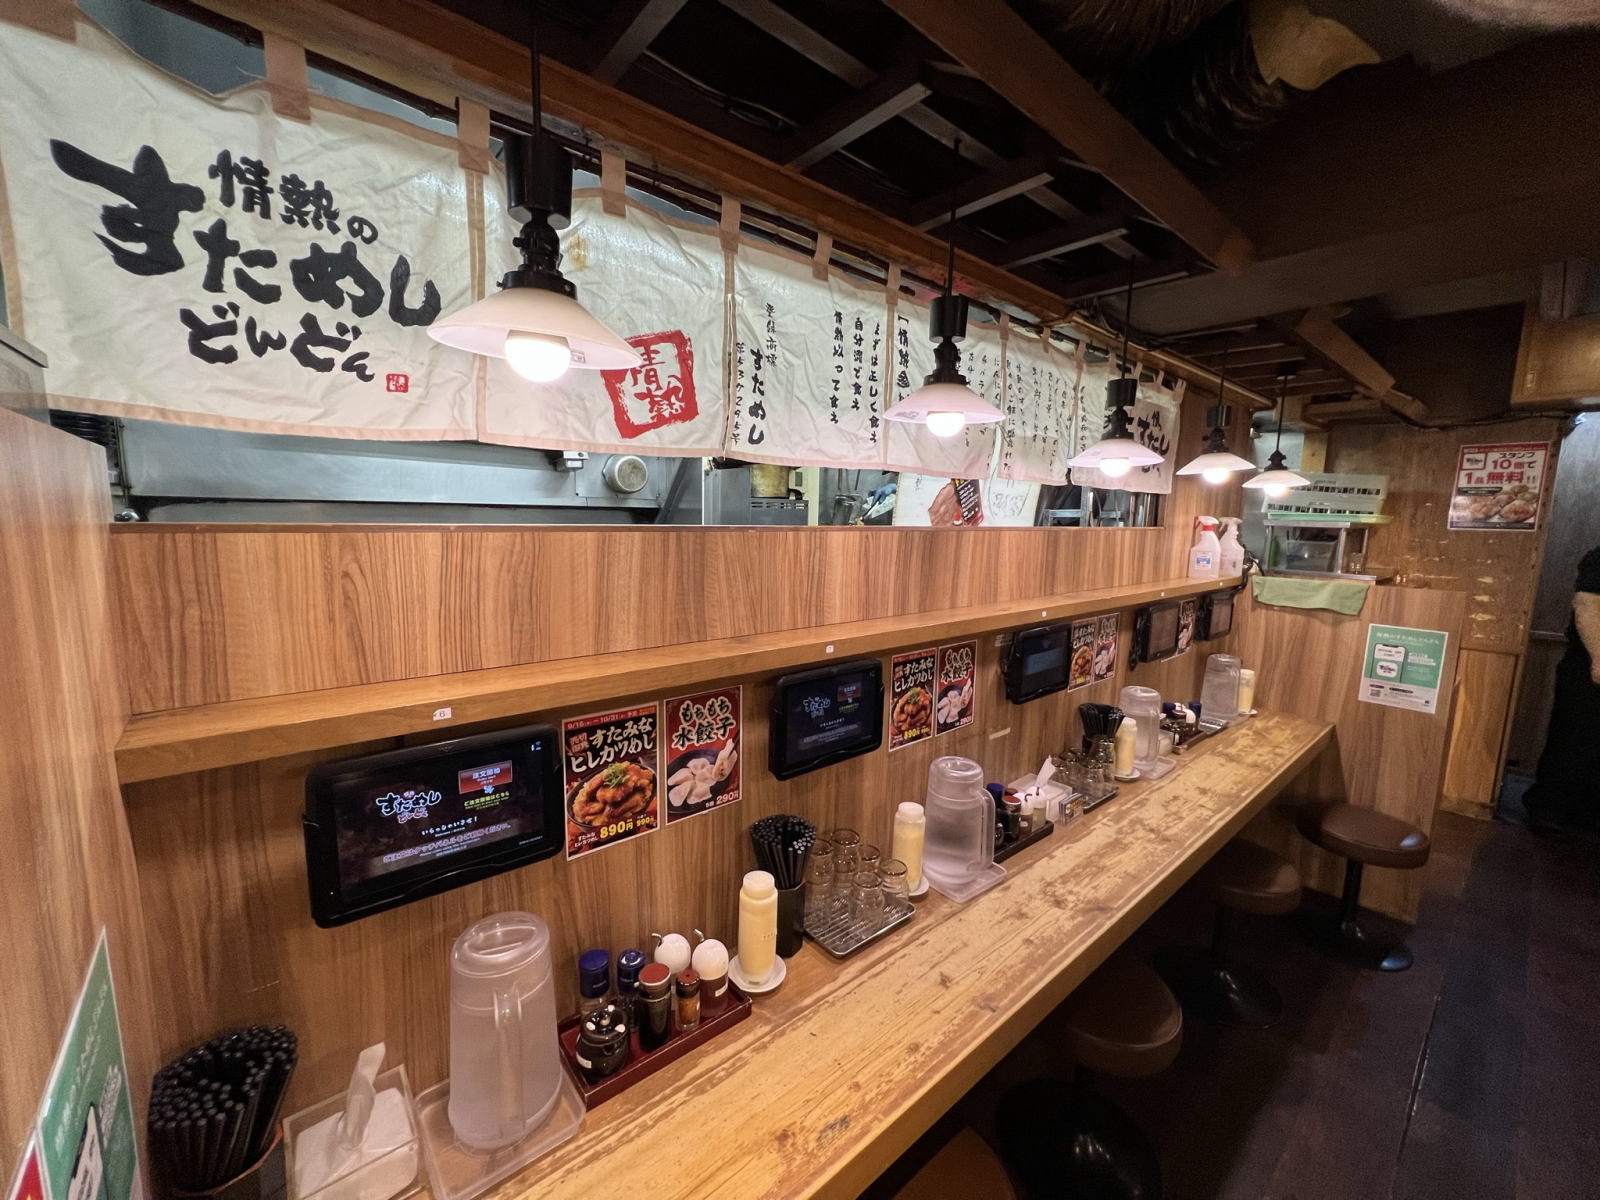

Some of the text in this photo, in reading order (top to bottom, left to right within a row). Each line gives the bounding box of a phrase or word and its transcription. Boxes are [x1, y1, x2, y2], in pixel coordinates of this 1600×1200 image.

[50, 138, 442, 330] すためし
[207, 149, 379, 245] 情熱の
[179, 301, 376, 382] どんどん
[851, 317, 864, 411] 自分流で食え
[748, 348, 766, 445] すためし
[589, 717, 654, 749] すたみな
[672, 714, 736, 750] 水餃子
[681, 697, 731, 724] もちもち
[570, 734, 654, 773] ヒレカツめし
